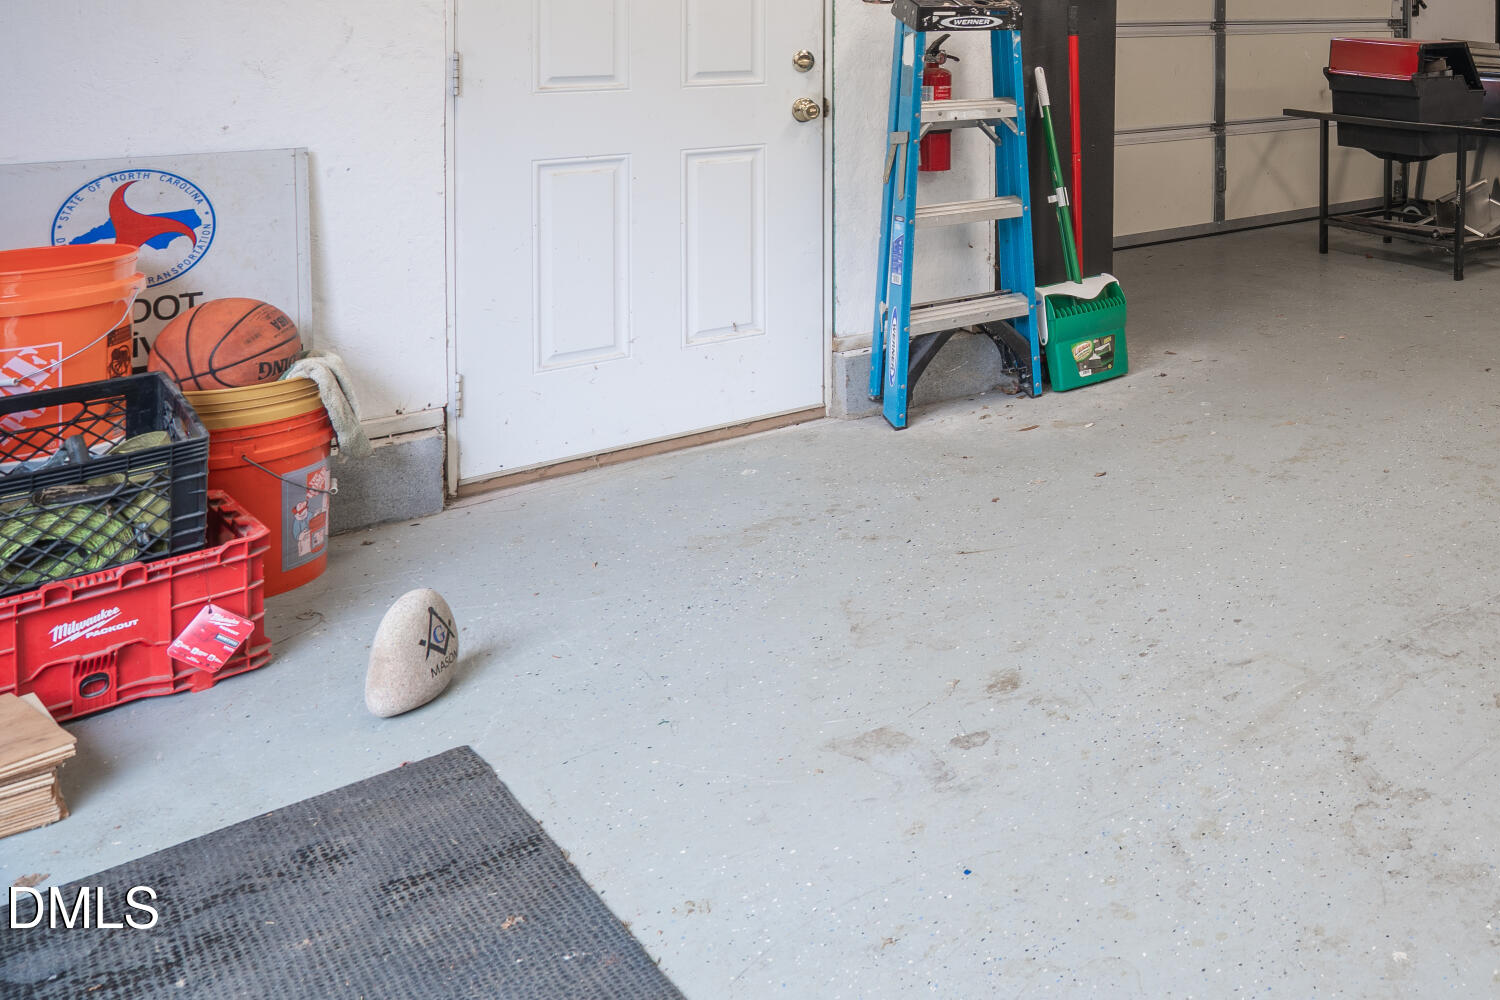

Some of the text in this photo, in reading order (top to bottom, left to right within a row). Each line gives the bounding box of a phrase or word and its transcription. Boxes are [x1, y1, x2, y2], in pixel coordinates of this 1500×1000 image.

[953, 18, 991, 26] WERNER
[60, 170, 205, 222] STATE OF NORTH CAROLINA
[147, 223, 212, 284] RANSPORTATION
[48, 606, 121, 642] Milwaukee
[85, 619, 139, 639] PACKOUT
[433, 625, 446, 644] G
